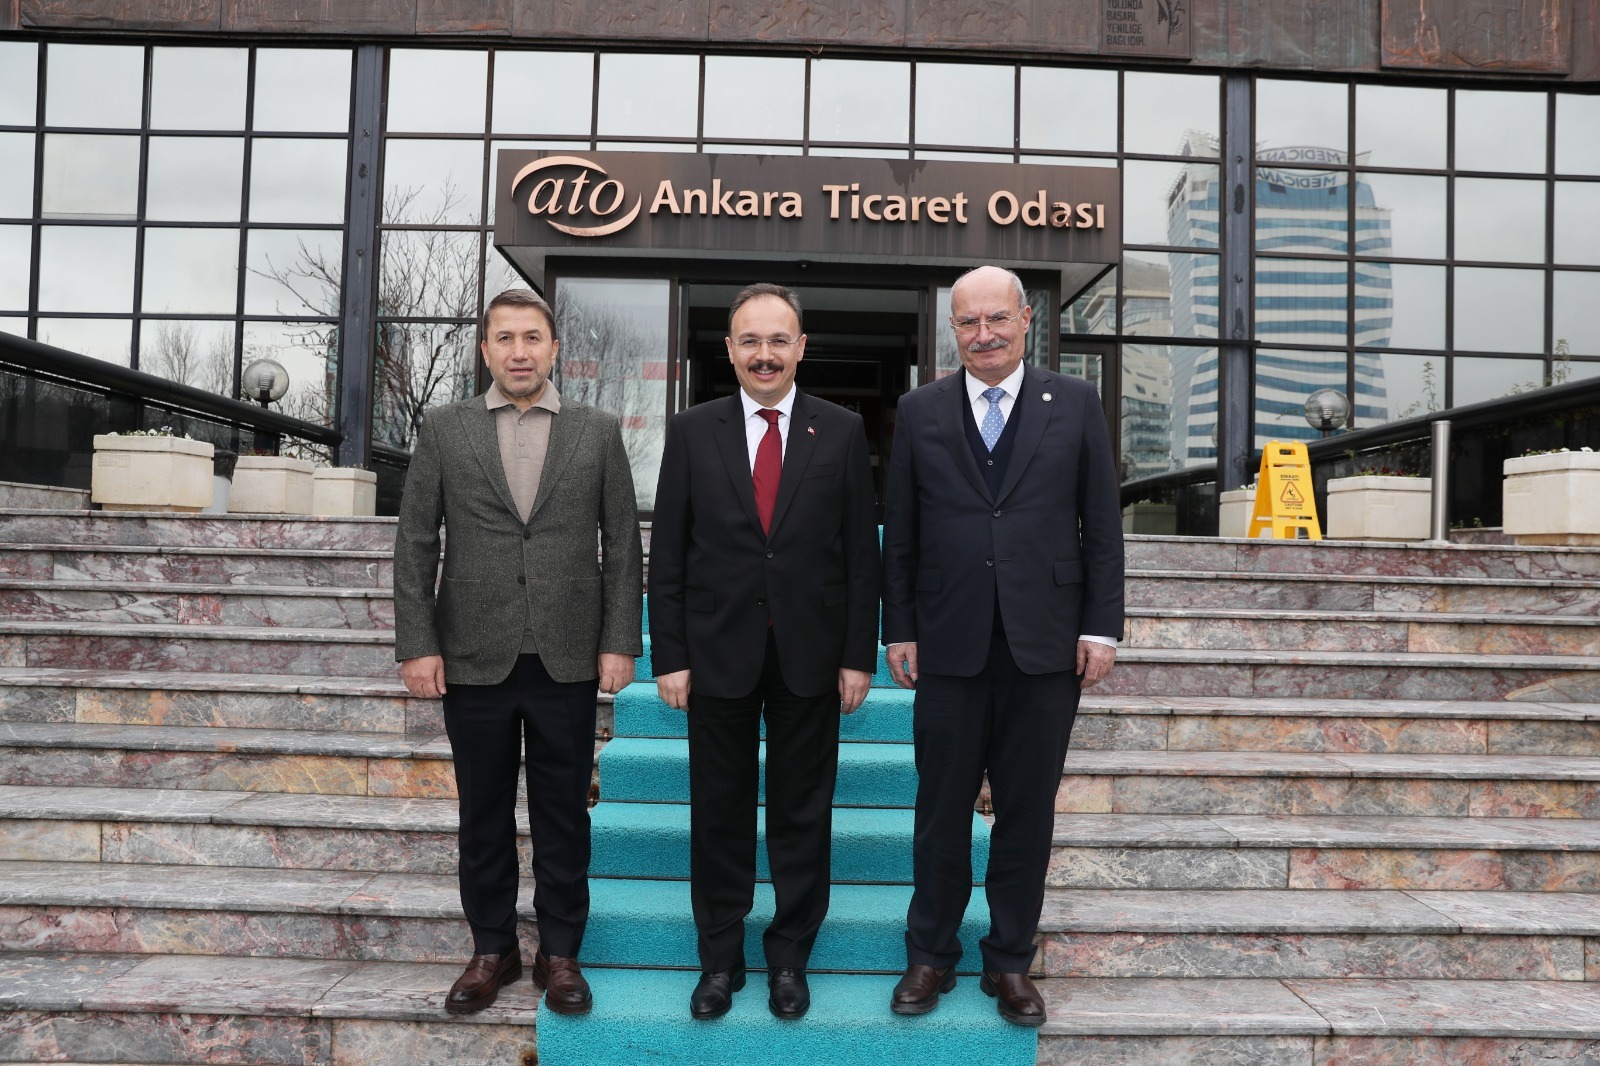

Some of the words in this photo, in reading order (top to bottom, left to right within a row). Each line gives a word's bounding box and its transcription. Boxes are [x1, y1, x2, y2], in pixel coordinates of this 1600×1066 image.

[1107, 0, 1144, 10] YOLUNDA
[527, 169, 625, 216] ato
[649, 178, 803, 218] Ankara
[822, 183, 969, 224] Ticaret
[987, 189, 1105, 229] Odası
